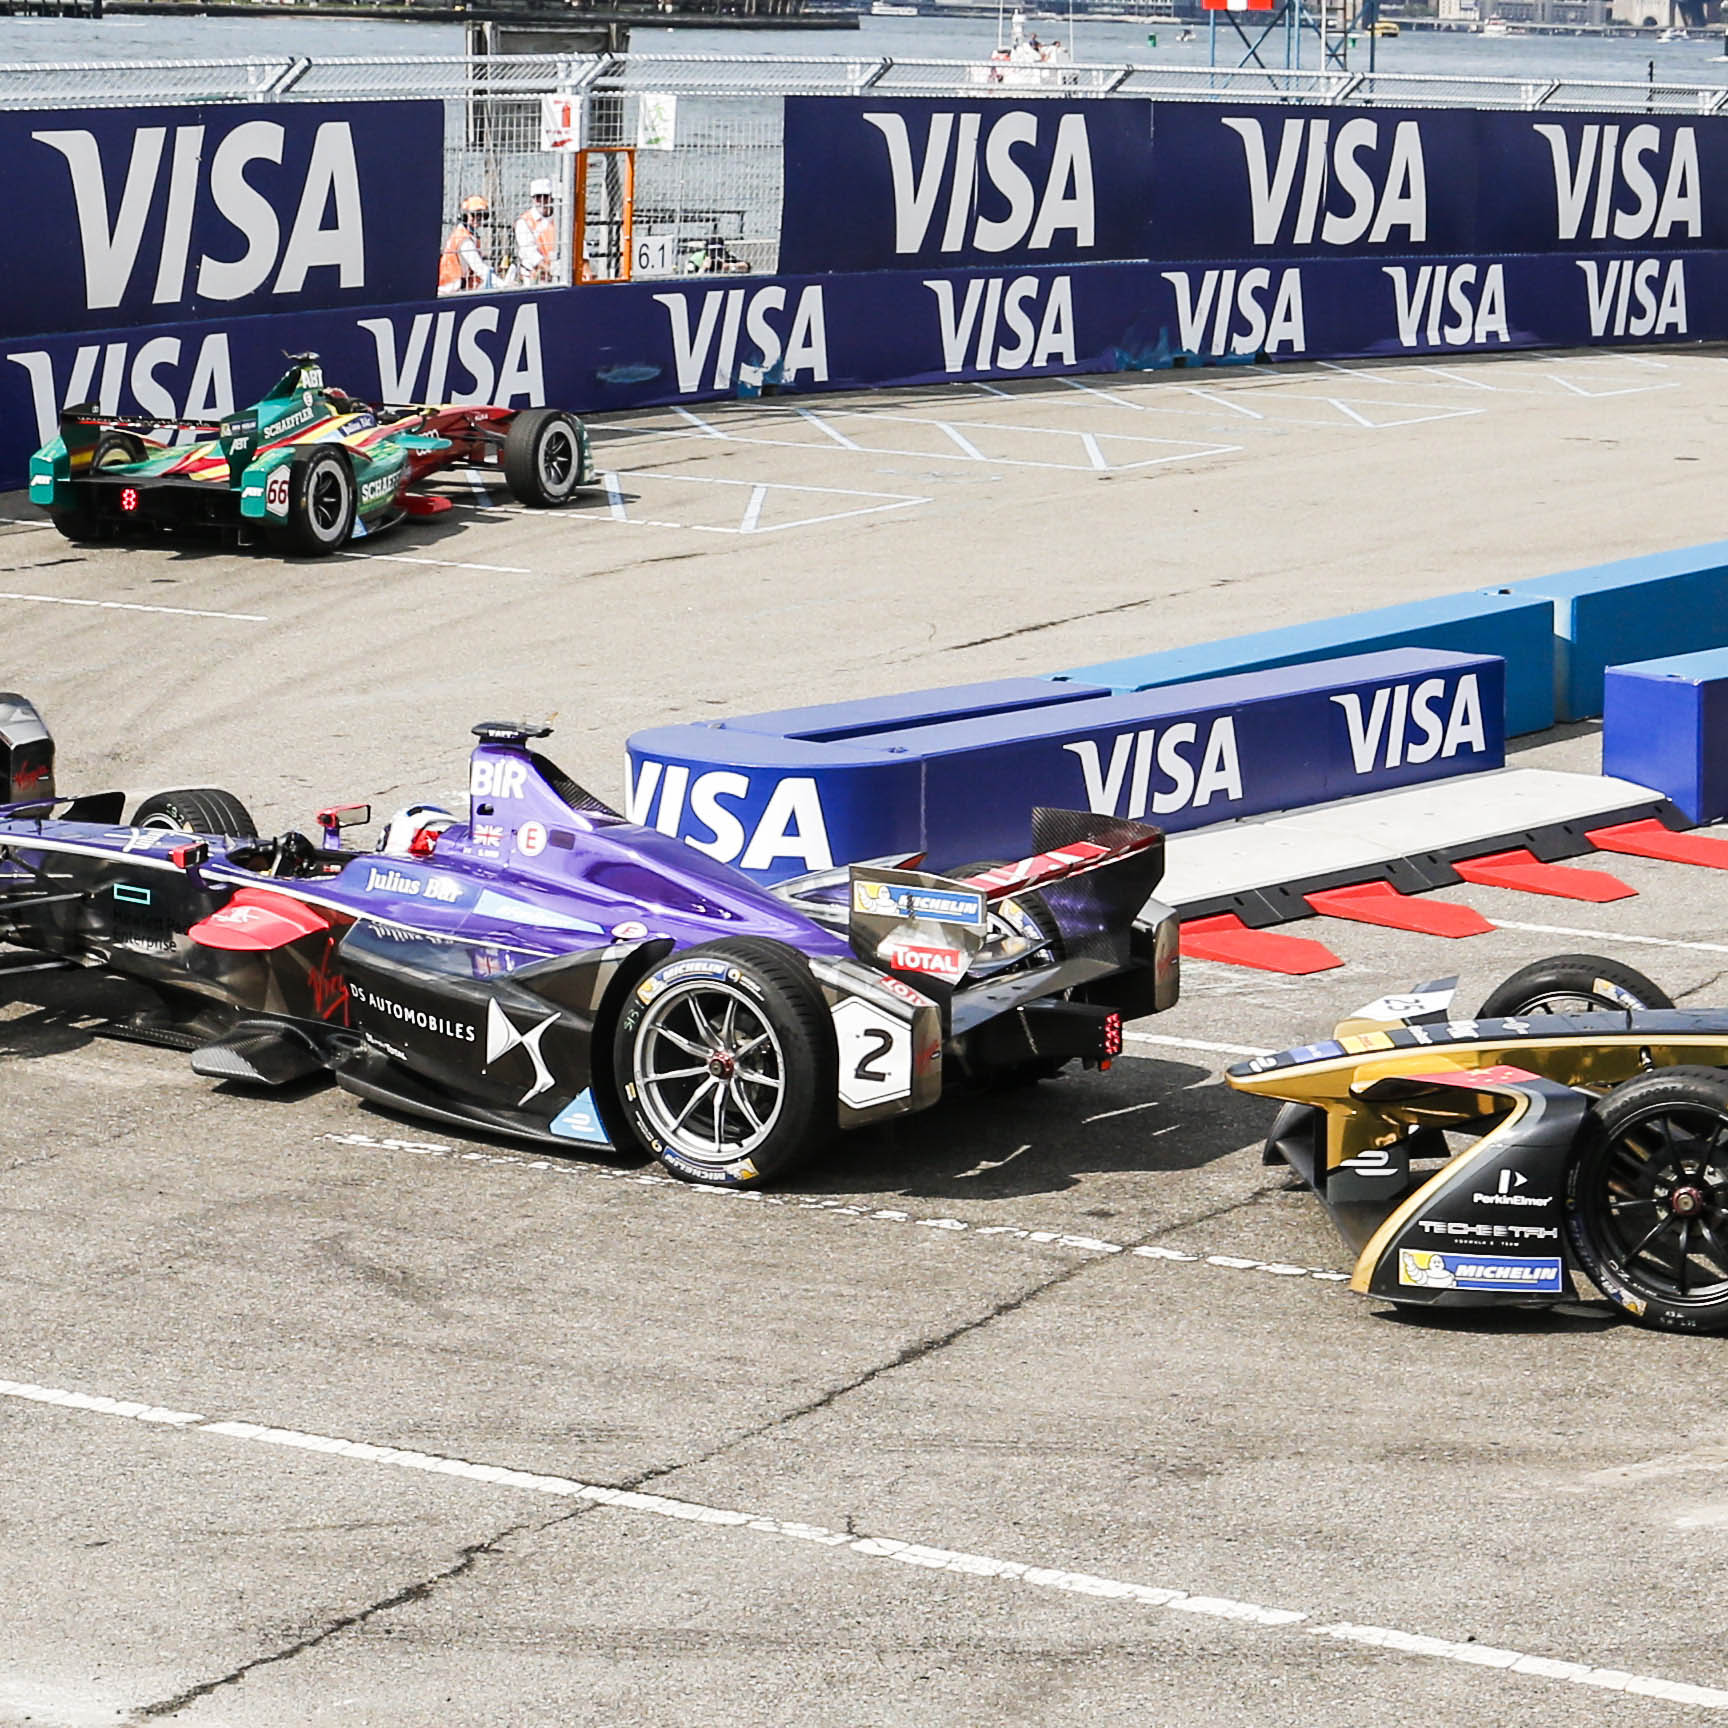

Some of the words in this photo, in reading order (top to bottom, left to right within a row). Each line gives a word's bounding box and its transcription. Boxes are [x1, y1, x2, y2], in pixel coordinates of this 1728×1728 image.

[863, 111, 1095, 253] VISA
[1222, 118, 1427, 244] VISA
[1534, 123, 1701, 239] VISA
[32, 120, 364, 309] VISA
[638, 243, 666, 270] 6.1
[924, 275, 1077, 373] VISA
[1162, 267, 1306, 356] VISA
[1383, 263, 1511, 348] VISA
[1576, 257, 1687, 336] VISA
[357, 302, 546, 406] VISA
[654, 284, 829, 394] VISA
[7, 332, 236, 447] VISA
[301, 368, 323, 389] ABT
[263, 407, 315, 440] SCHAEFFLER
[268, 479, 290, 505] 66
[1330, 674, 1486, 774] VISA
[471, 758, 529, 800] BIR
[1063, 716, 1244, 819] VISA
[366, 868, 421, 895] Julius
[898, 894, 978, 915] MICHELIN
[663, 962, 726, 982] MICHELIN
[895, 947, 958, 972] TOTAL
[350, 983, 366, 1002] DS
[369, 993, 476, 1042] AUTOMOBILES
[854, 1028, 894, 1083] 2
[664, 1153, 726, 1181] MICHELIN
[1473, 1192, 1549, 1207] PerkinElmer
[1418, 1220, 1559, 1239] TECHEETAH
[1456, 1264, 1558, 1281] MICHELIN
